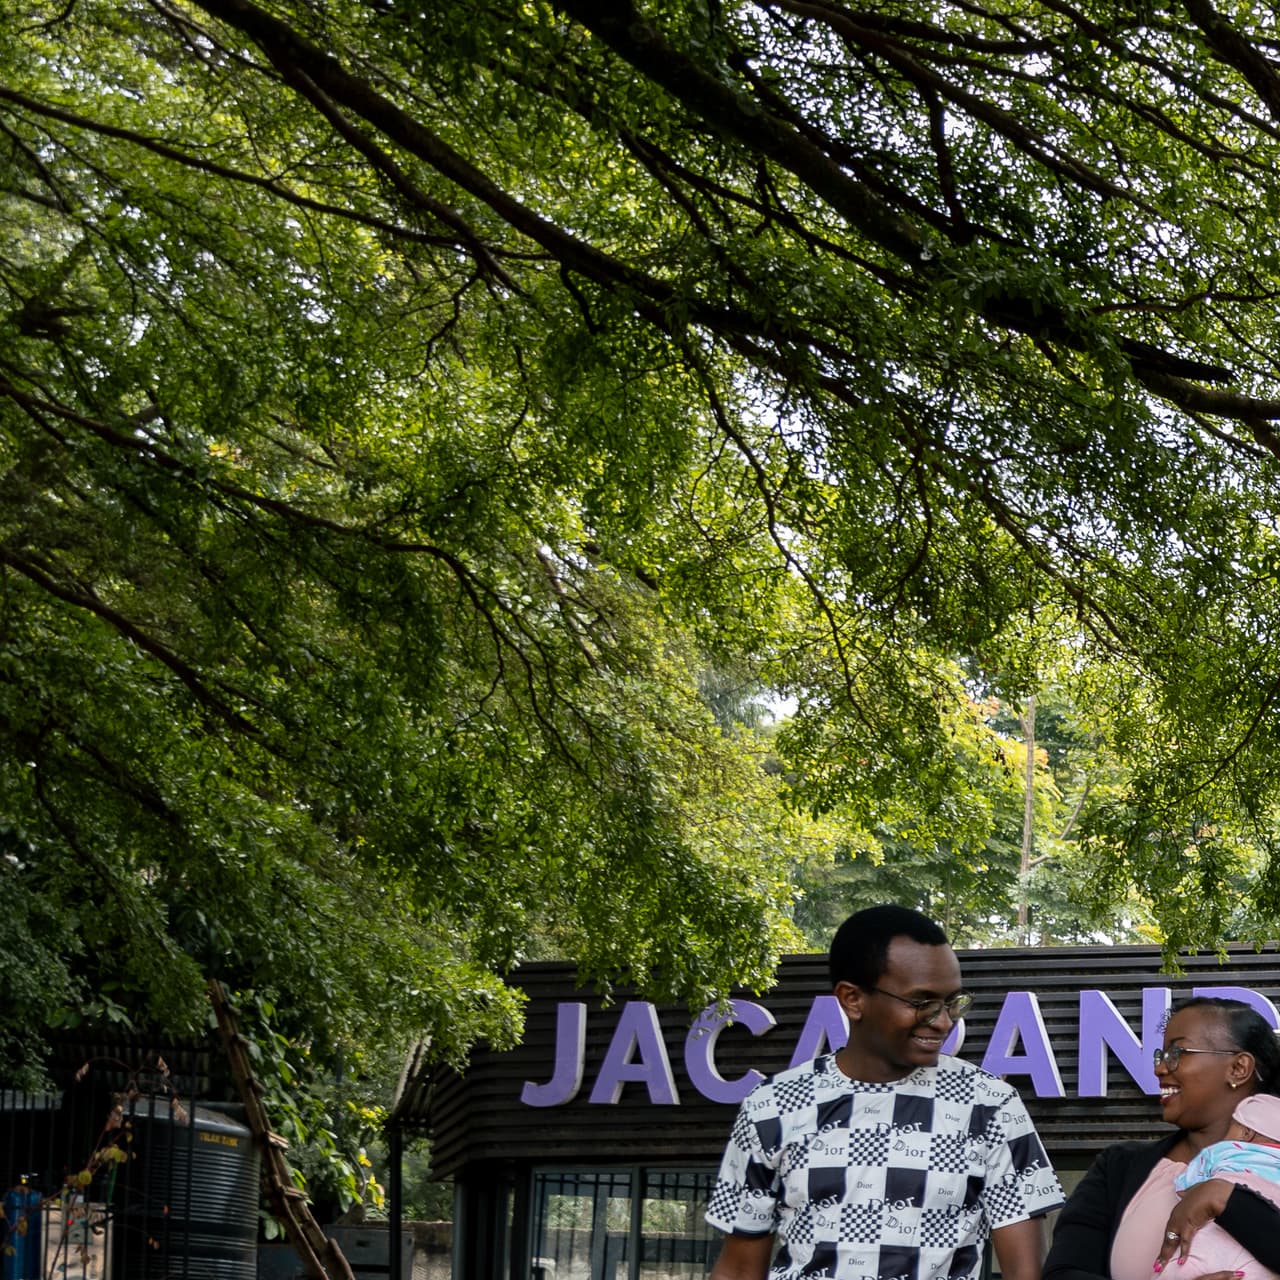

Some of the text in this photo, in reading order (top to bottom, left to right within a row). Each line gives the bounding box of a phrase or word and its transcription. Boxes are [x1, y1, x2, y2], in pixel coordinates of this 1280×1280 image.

[1001, 1112, 1028, 1125] Dior
[875, 1121, 922, 1137] Dior
[811, 1138, 845, 1156] Dior
[892, 1139, 927, 1158] Dior
[1002, 1159, 1040, 1188] Dior
[1024, 1183, 1056, 1197] Dior
[868, 1196, 915, 1214] Dior
